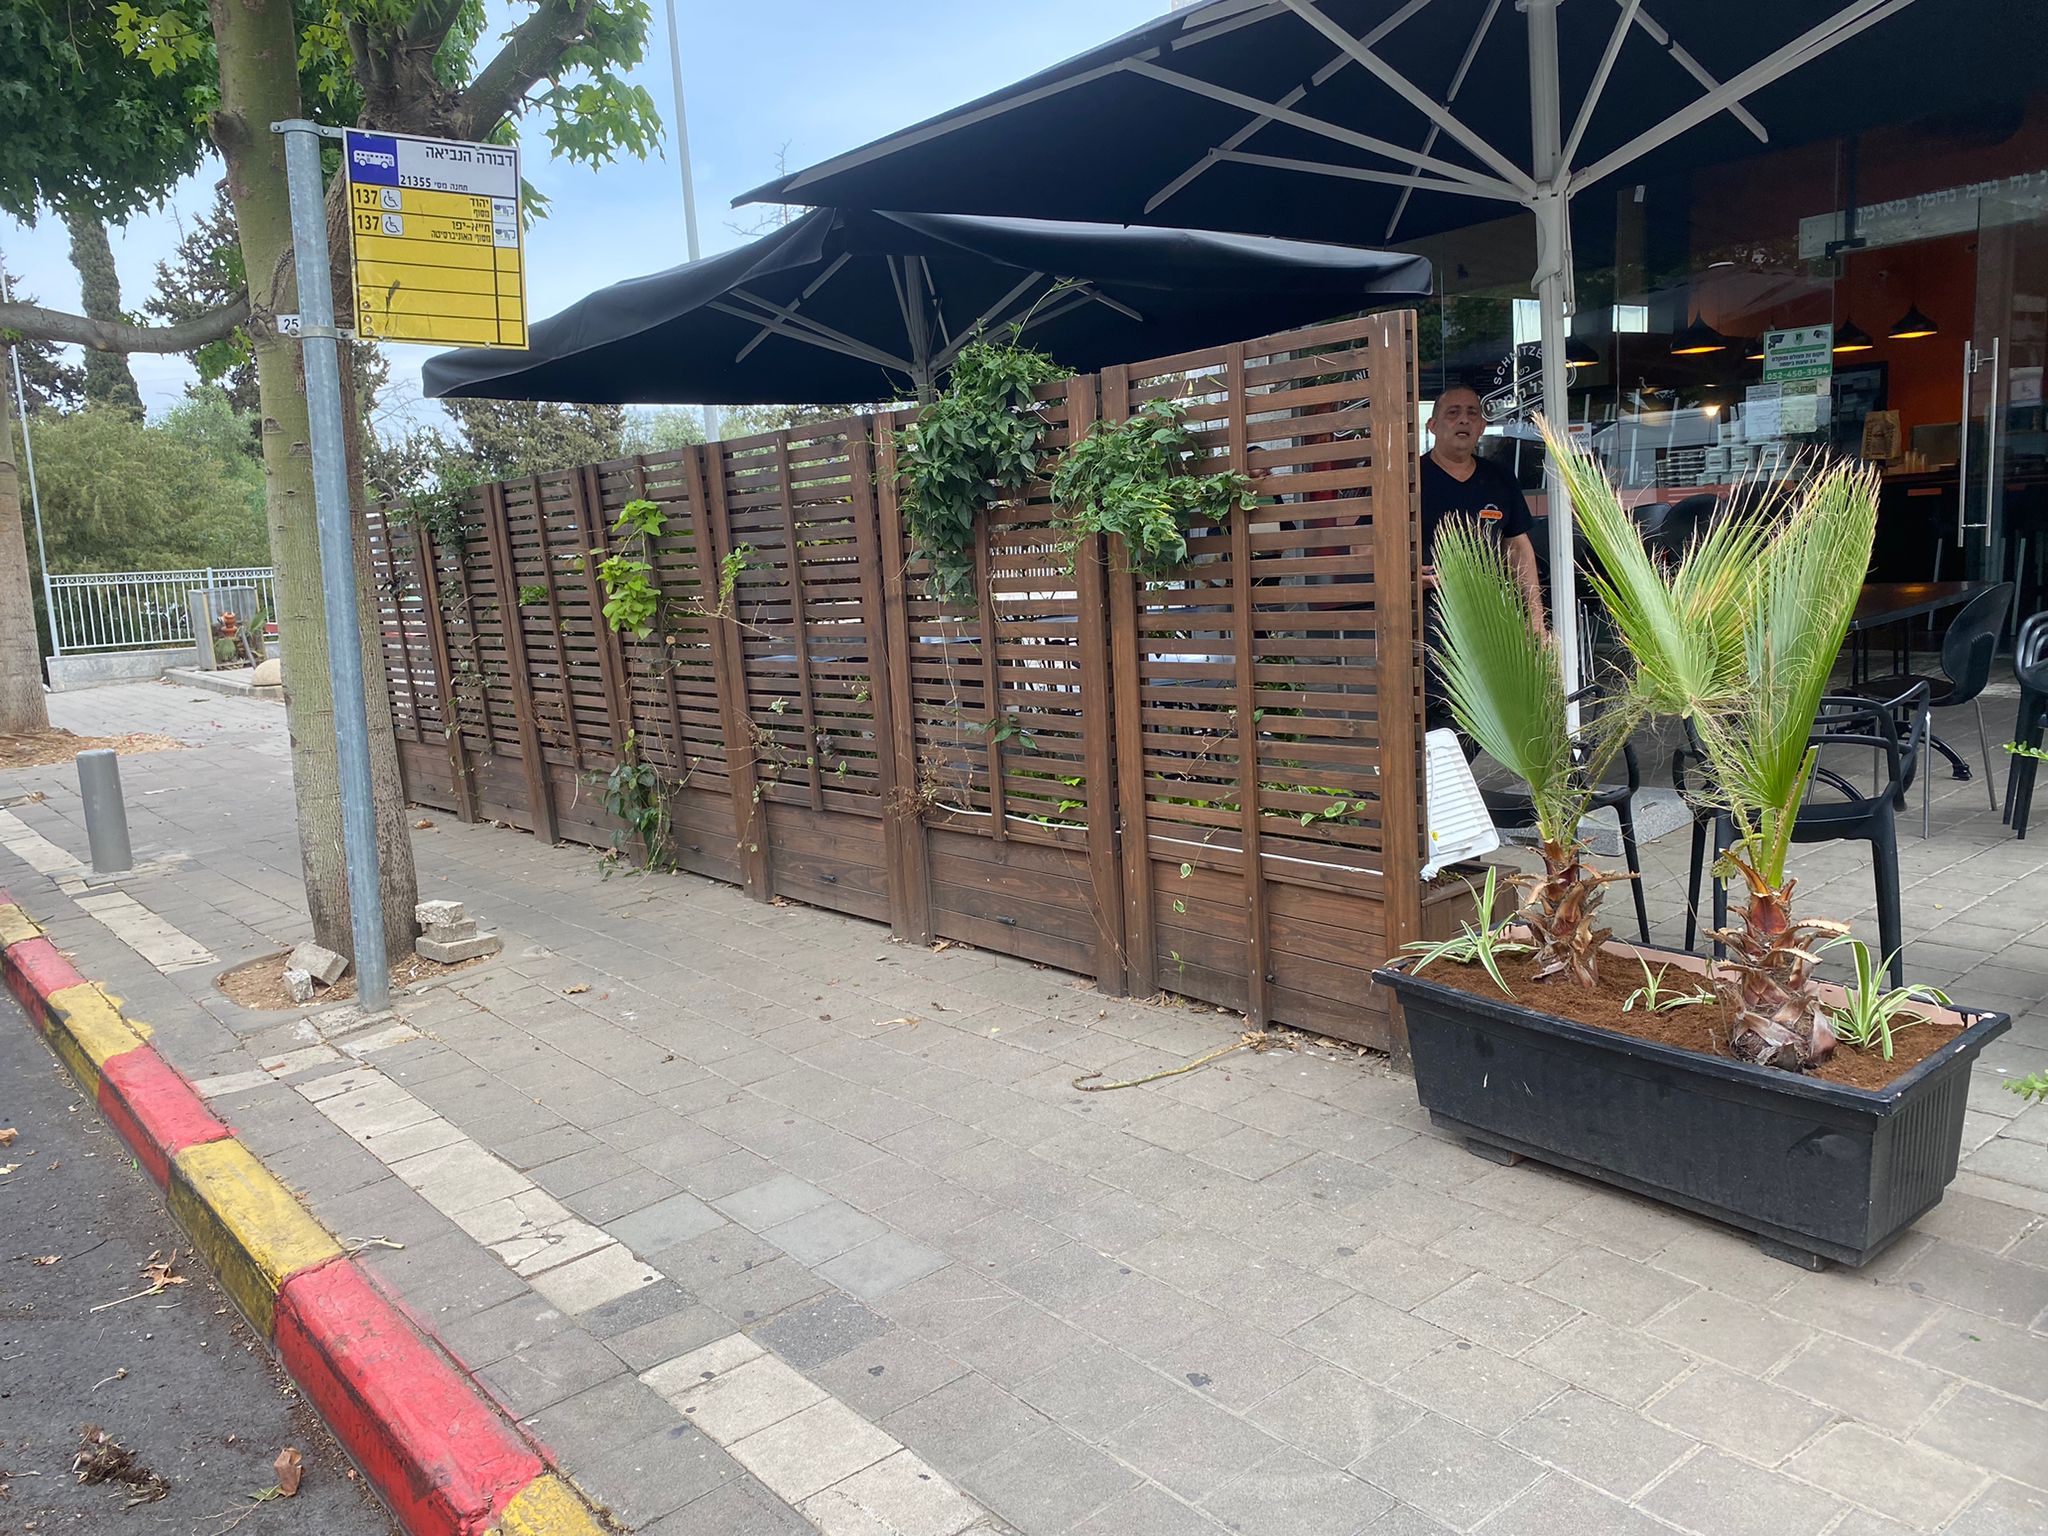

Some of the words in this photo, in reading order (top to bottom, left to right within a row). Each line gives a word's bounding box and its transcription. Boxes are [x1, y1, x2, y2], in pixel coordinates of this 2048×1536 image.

[426, 146, 472, 162] הנביאה
[476, 152, 513, 167] דבורה
[400, 174, 431, 188] 21355
[449, 183, 468, 191] תחנה
[356, 188, 378, 204] 137
[469, 197, 489, 208] יהוד
[473, 209, 490, 218] מסוף
[357, 214, 379, 230] 137
[474, 233, 491, 244] מסוף
[1767, 367, 1828, 380] 052-450-3994
